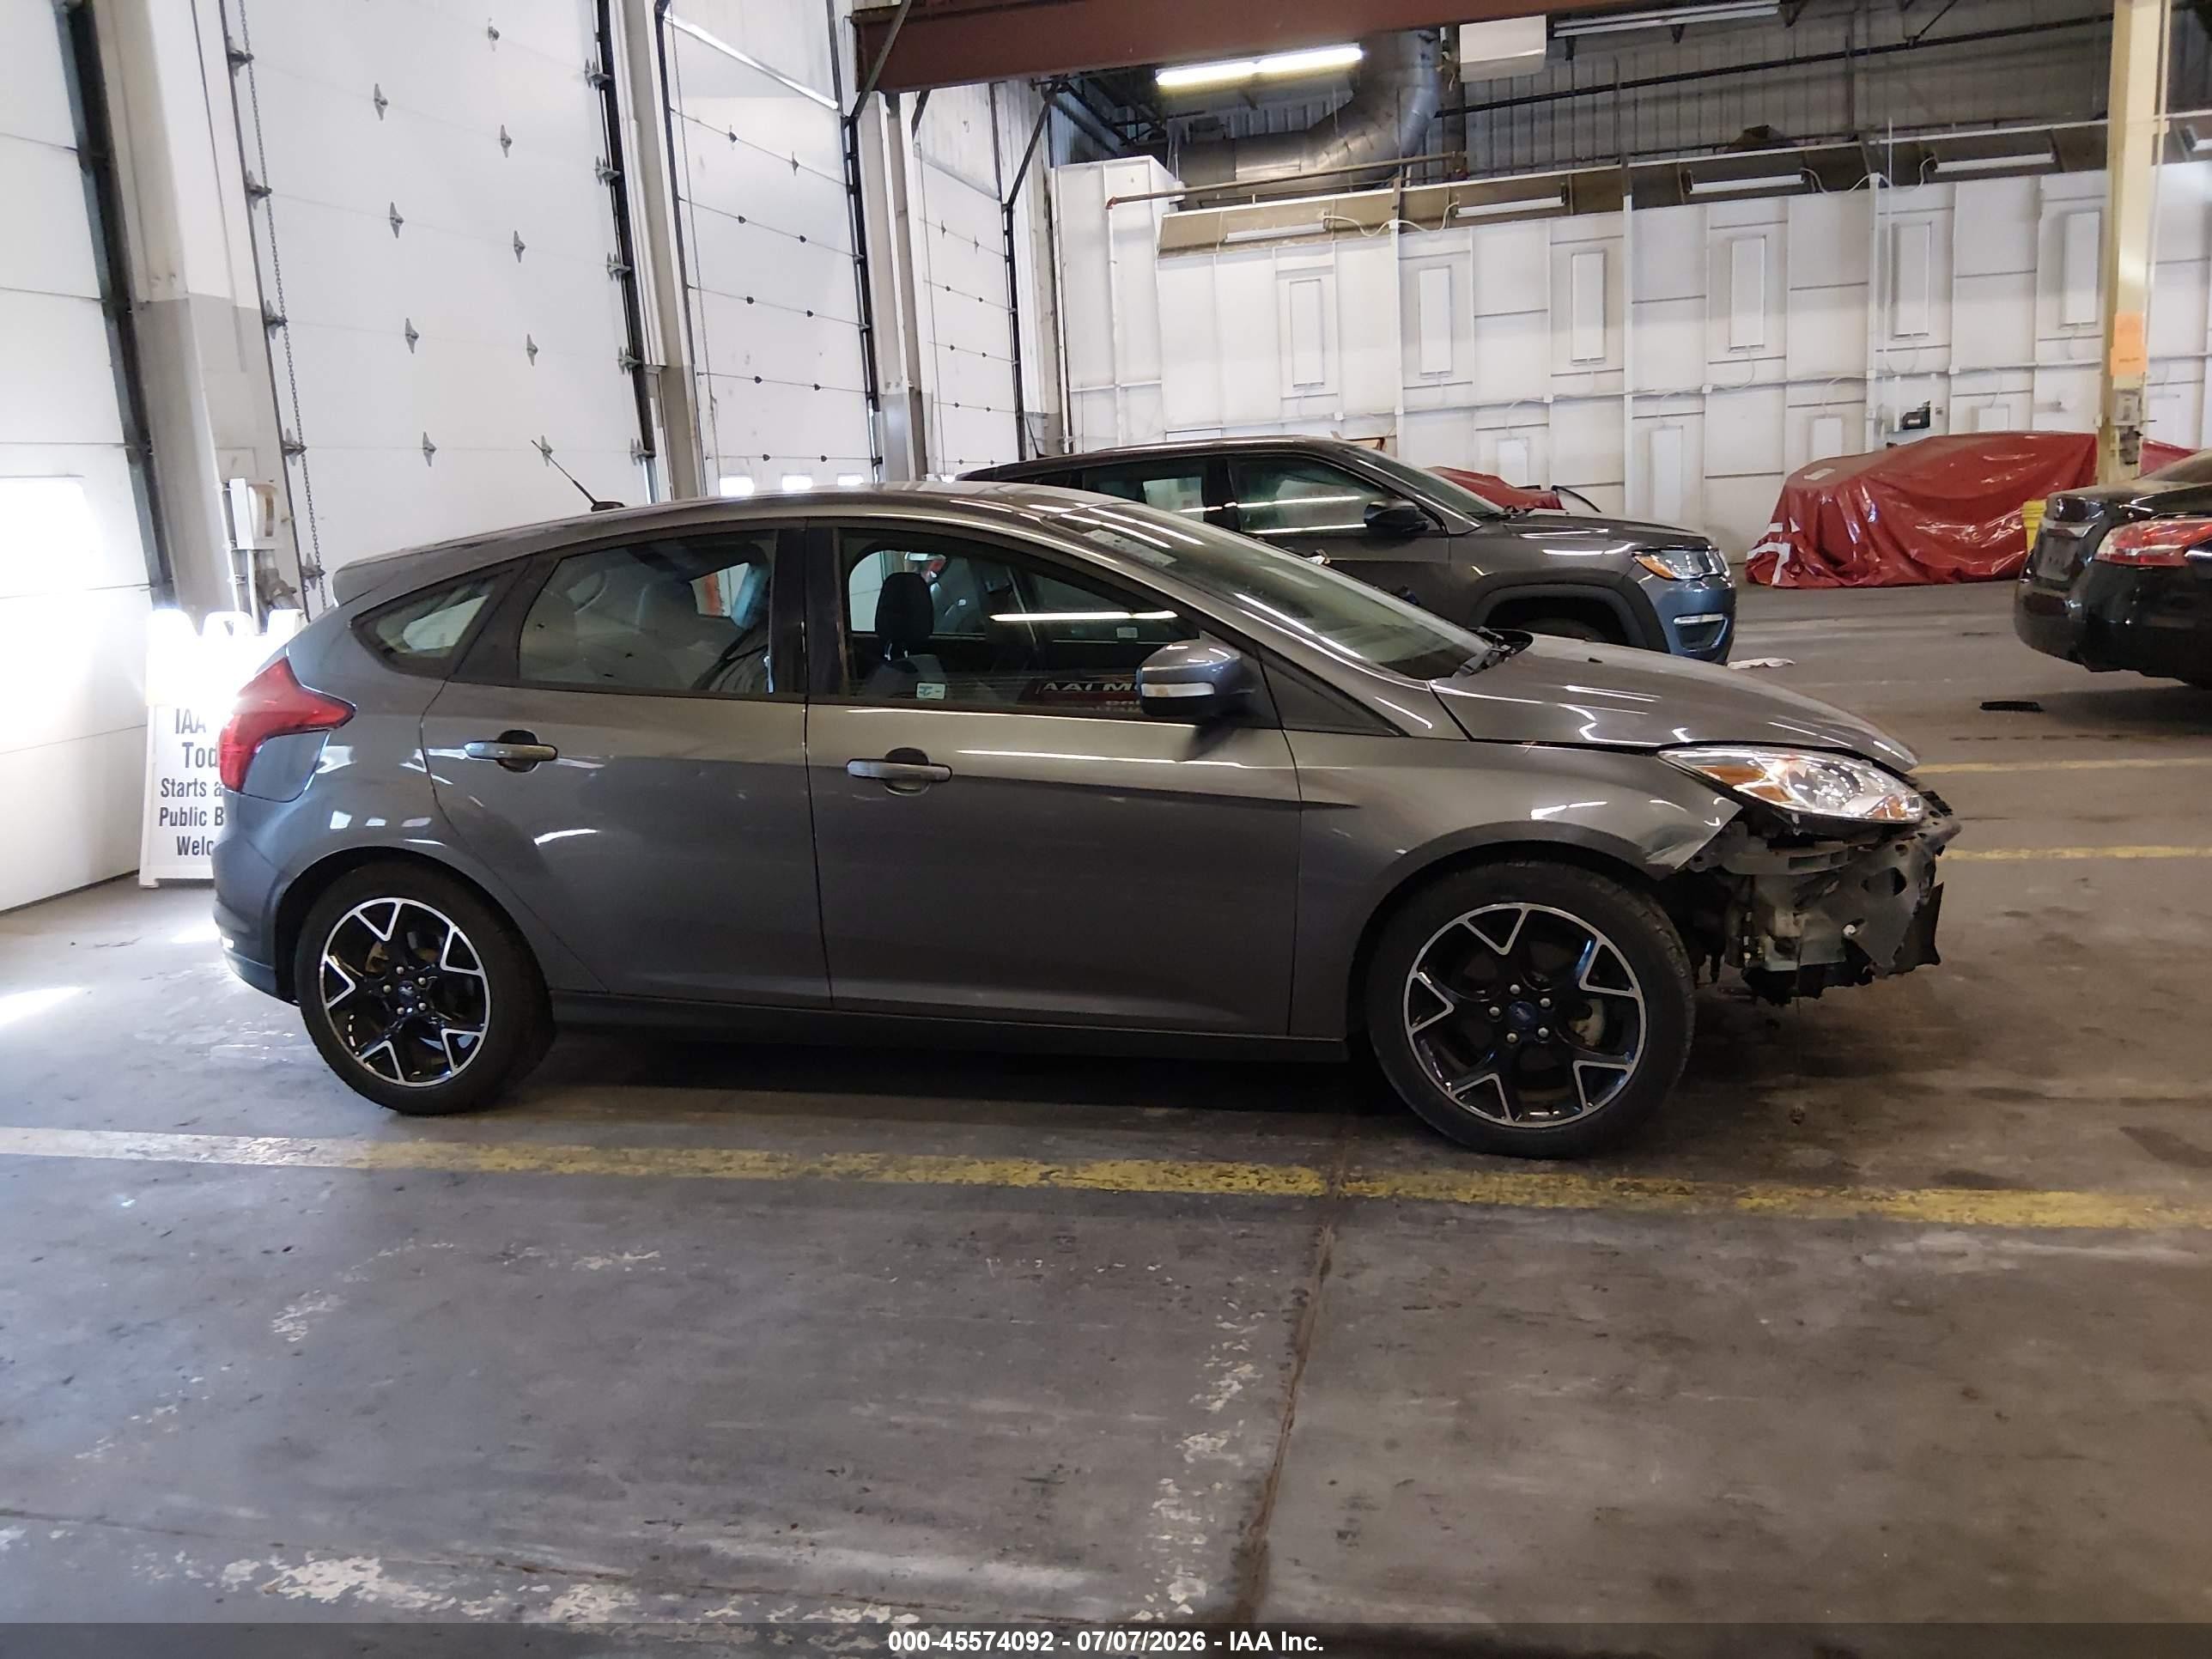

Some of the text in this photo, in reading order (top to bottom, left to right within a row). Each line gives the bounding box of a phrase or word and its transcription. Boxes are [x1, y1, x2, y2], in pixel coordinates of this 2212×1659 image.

[175, 708, 207, 734] IAA
[161, 778, 207, 798] Starts
[159, 807, 207, 826] Public
